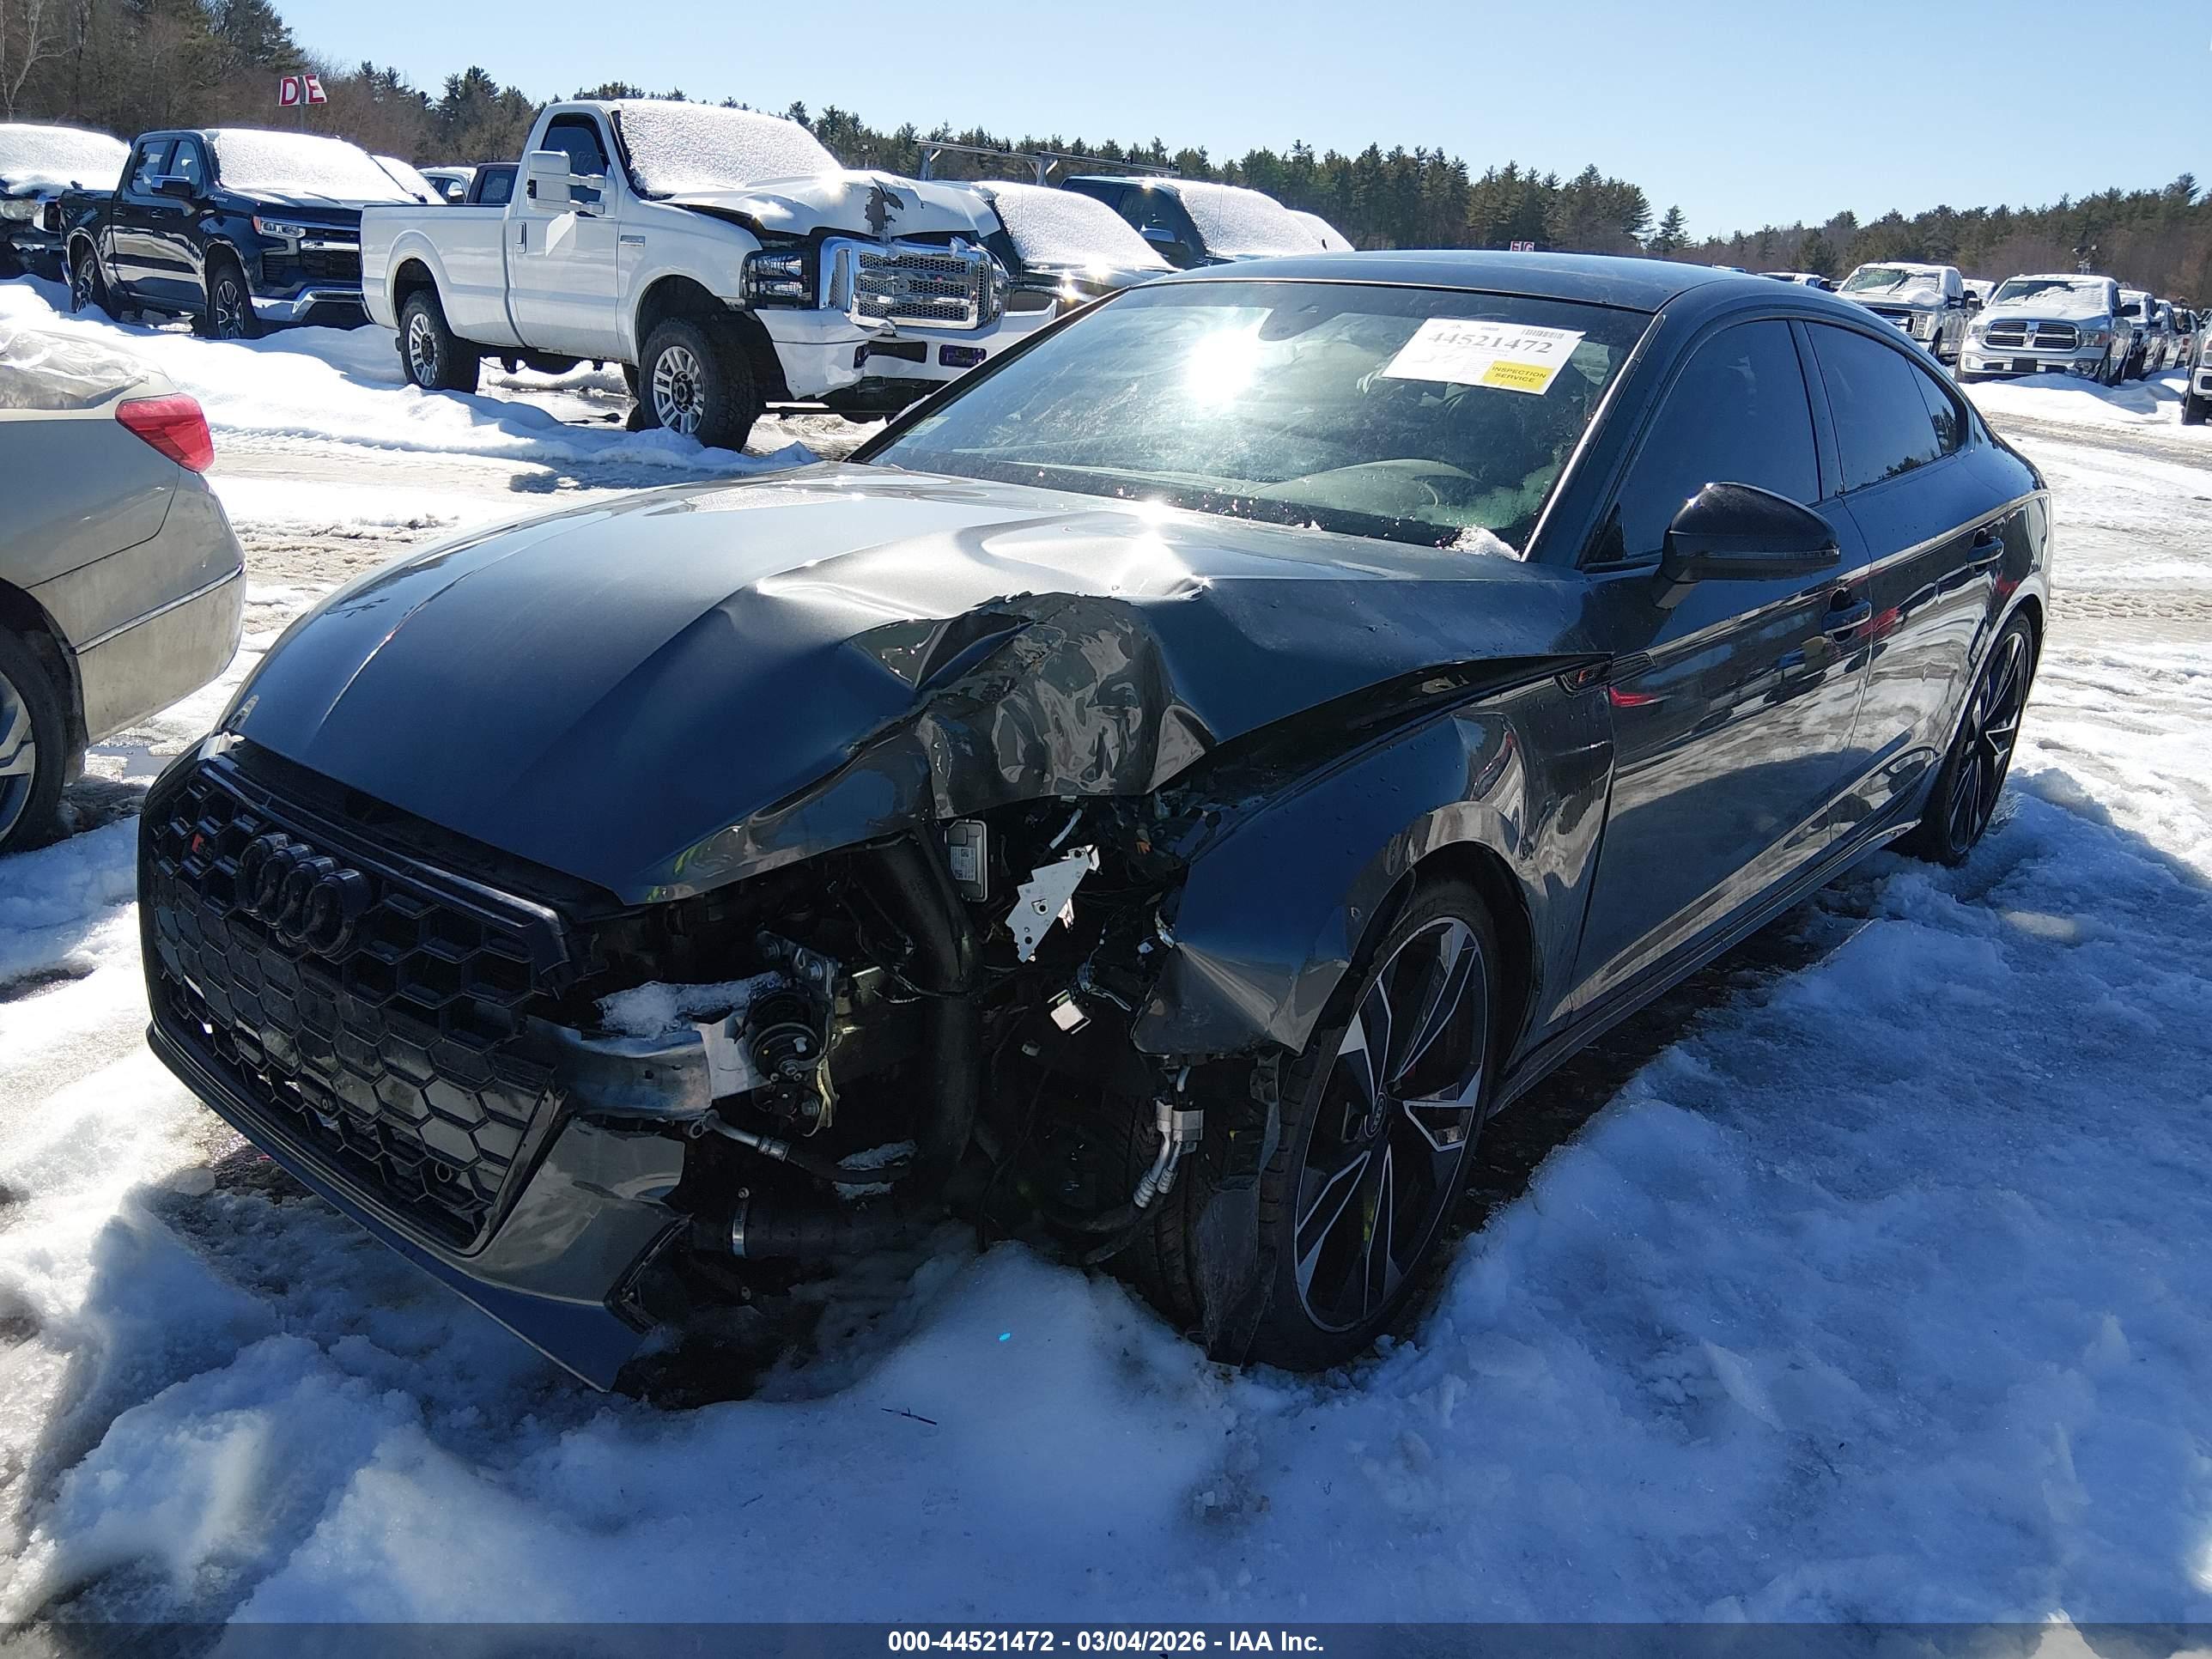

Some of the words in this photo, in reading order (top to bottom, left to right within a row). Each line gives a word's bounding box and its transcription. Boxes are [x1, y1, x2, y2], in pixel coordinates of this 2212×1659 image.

[1428, 331, 1553, 353] 44521472
[1492, 366, 1547, 378] INSPECTION
[1494, 373, 1536, 383] SERVICE
